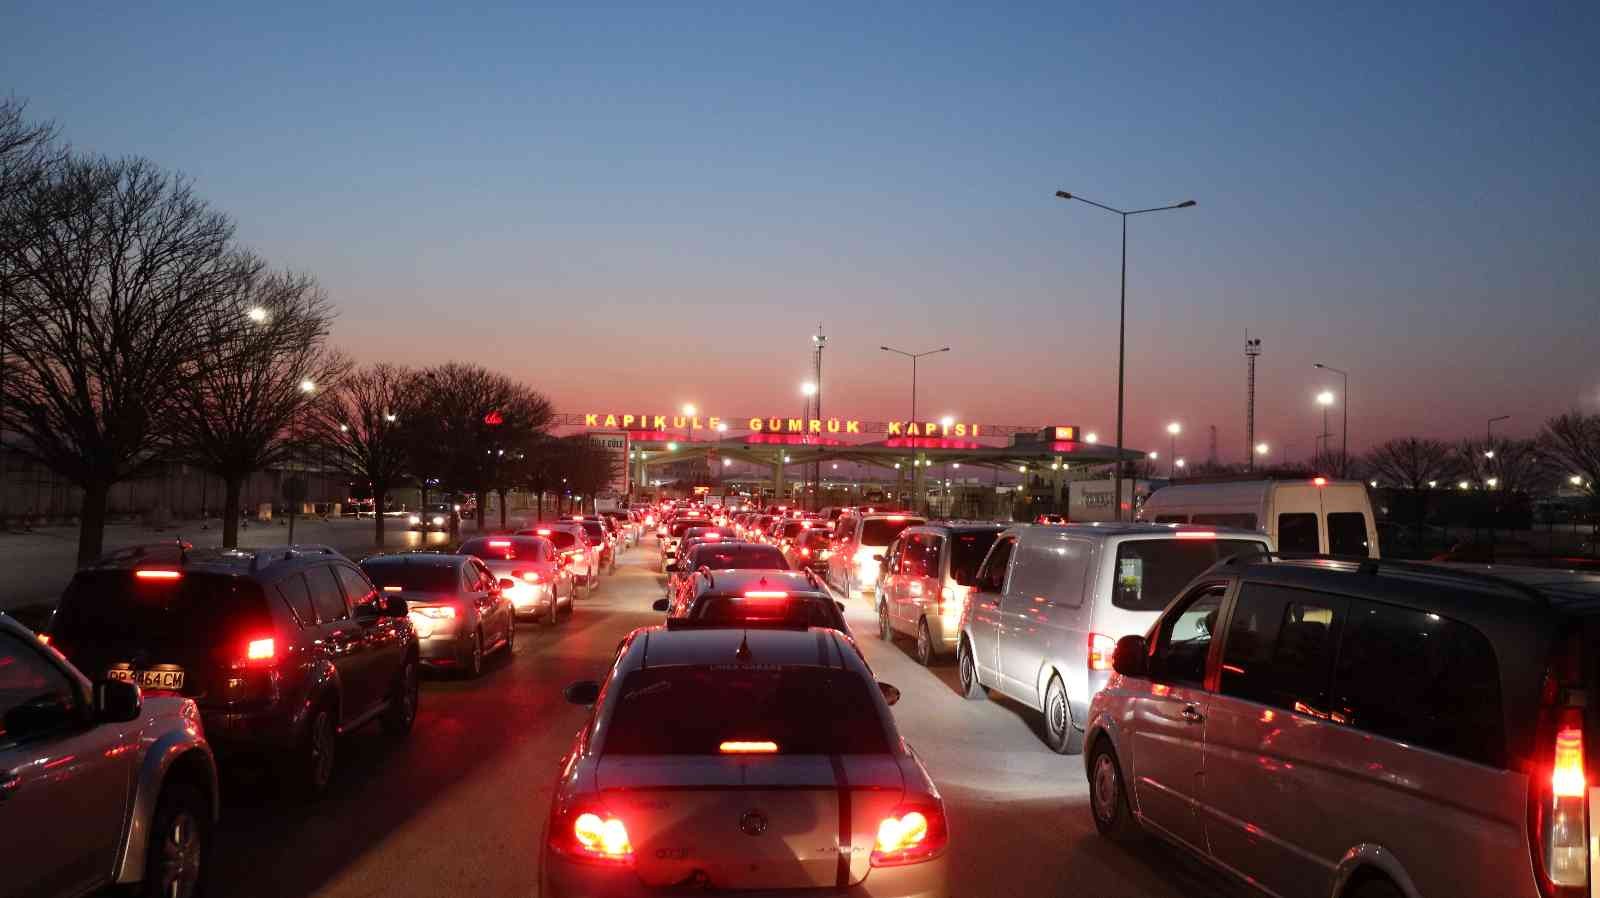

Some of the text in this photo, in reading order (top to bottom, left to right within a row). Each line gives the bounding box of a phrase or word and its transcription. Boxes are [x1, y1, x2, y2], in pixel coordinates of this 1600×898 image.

[585, 413, 978, 437] KAPIKULE GÜMRÜK KAPISI
